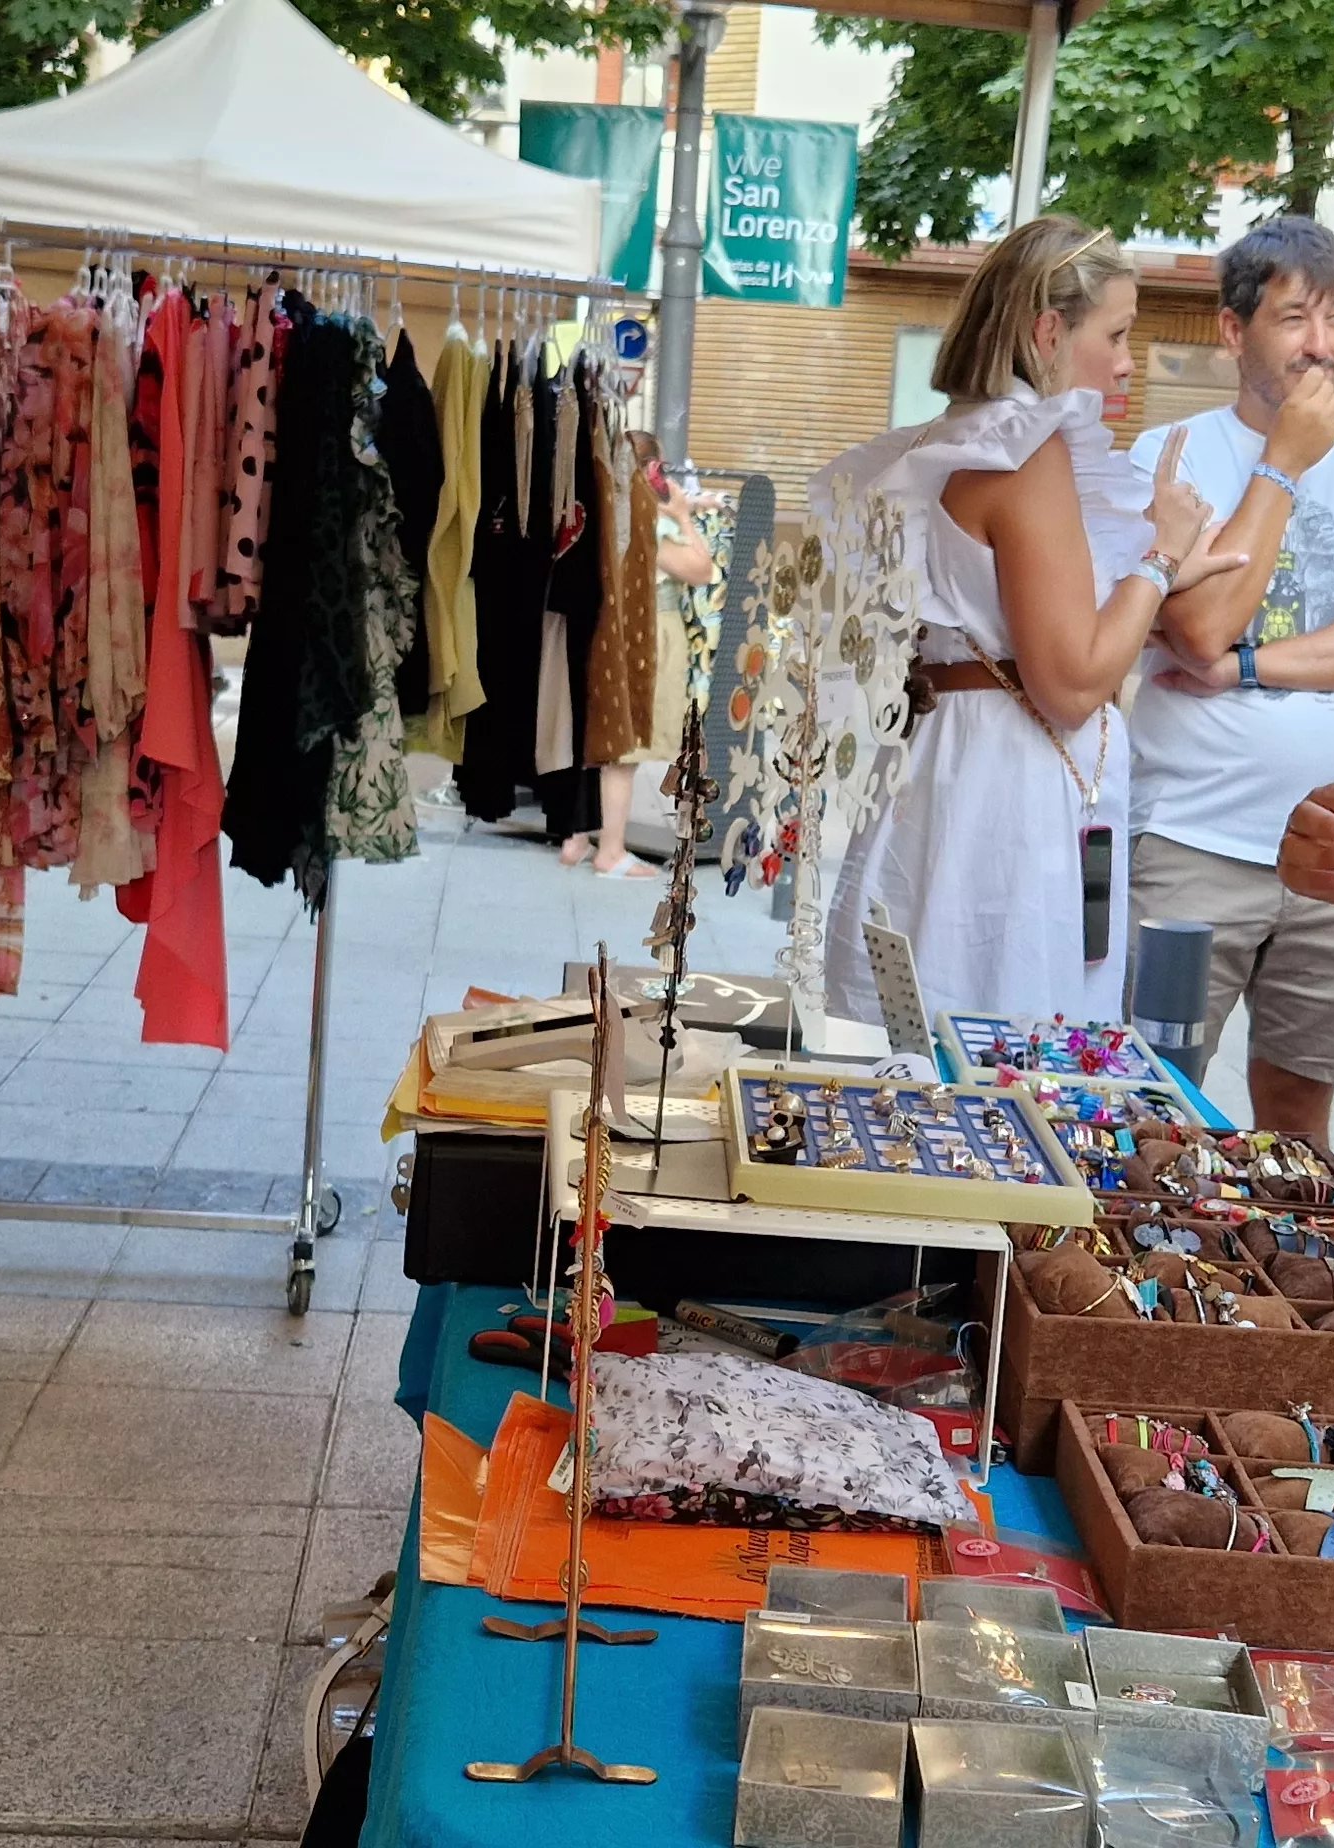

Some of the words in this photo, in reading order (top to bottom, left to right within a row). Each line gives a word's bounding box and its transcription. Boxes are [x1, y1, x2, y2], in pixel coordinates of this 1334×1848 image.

[726, 153, 782, 178] vive
[724, 176, 779, 208] San
[722, 206, 838, 243] Lorenzo
[686, 1311, 713, 1329] BIC
[736, 1567, 767, 1586] La
